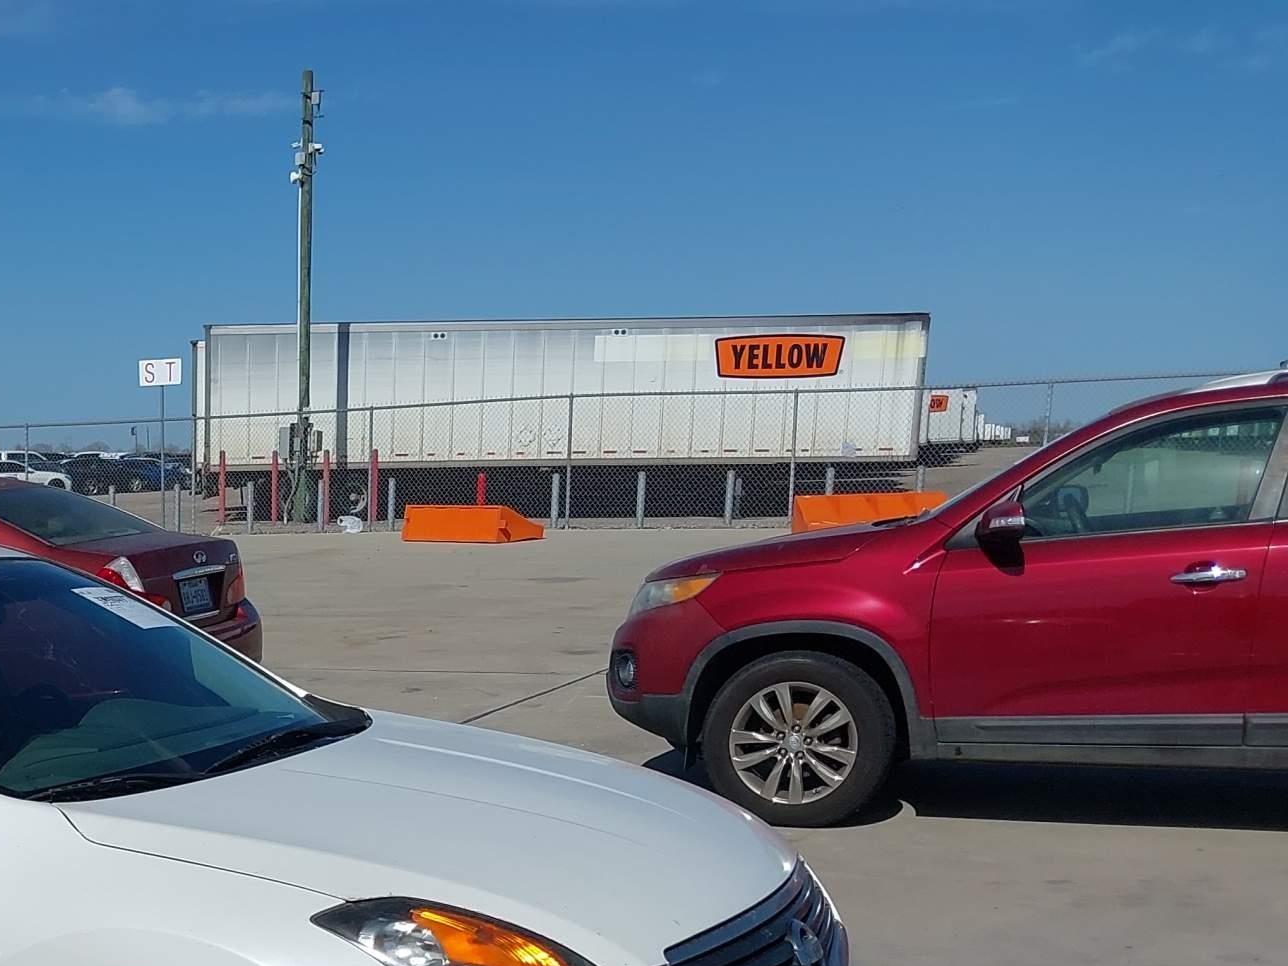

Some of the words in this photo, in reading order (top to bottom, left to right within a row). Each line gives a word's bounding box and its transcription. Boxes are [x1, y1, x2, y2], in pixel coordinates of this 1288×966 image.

[731, 342, 828, 370] YELLOW
[144, 362, 155, 384] S
[165, 361, 176, 382] T
